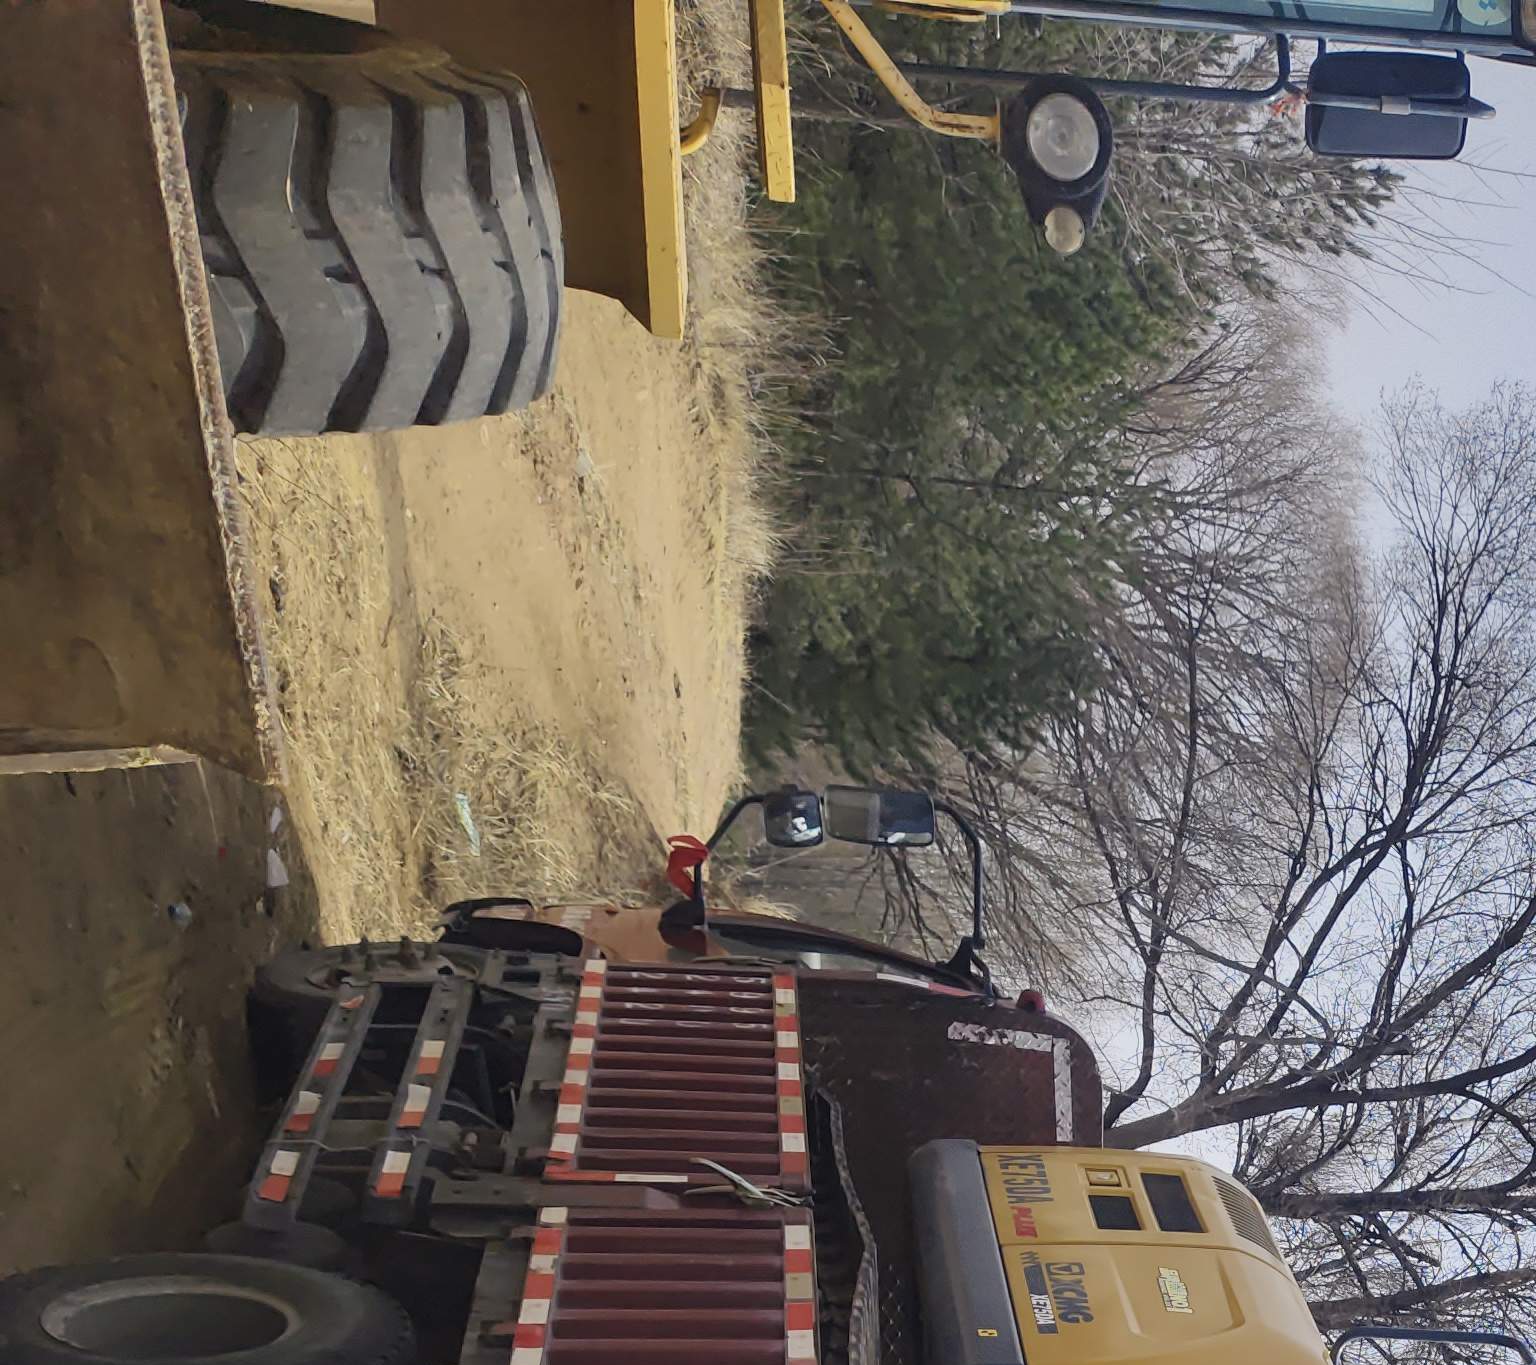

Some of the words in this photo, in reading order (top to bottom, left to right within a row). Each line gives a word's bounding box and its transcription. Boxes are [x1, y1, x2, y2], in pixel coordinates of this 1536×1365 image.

[998, 1154, 1054, 1204] XE75DA
[1030, 1294, 1058, 1325] XE75DA
[1048, 1273, 1094, 1324] XCMG
